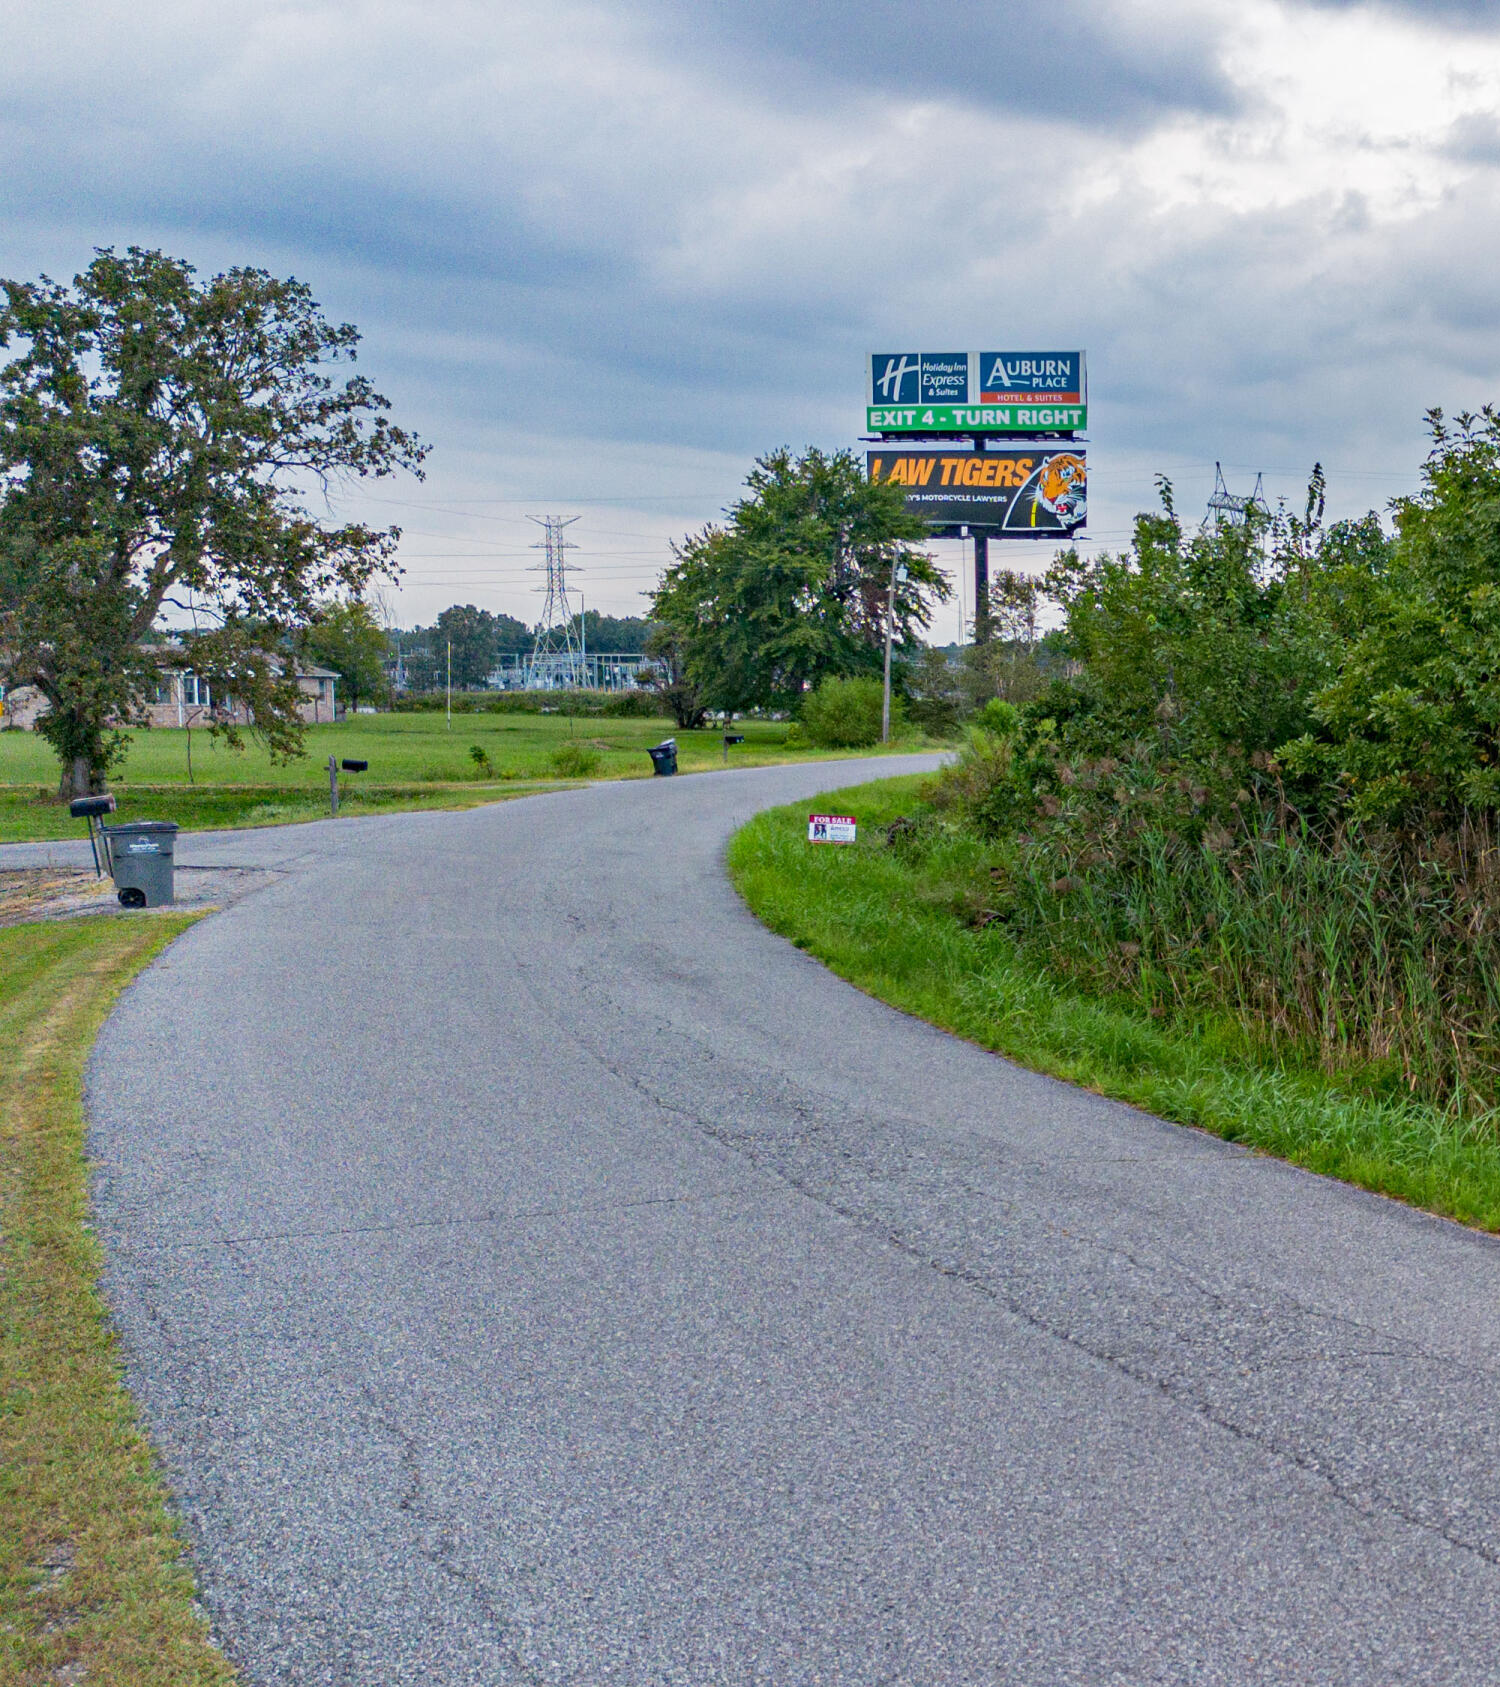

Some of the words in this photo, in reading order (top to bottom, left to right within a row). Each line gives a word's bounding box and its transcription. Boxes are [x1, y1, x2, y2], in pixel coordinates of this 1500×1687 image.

[923, 362, 953, 373] Holiday
[954, 362, 967, 372] Inn
[986, 358, 1071, 387] AUBURN
[923, 374, 965, 388] Express
[1032, 377, 1068, 388] PLACE
[928, 388, 935, 396] &
[936, 388, 959, 396] Suites
[997, 394, 1025, 402] HOTEL
[1026, 394, 1033, 402] &
[1034, 394, 1063, 402] SUITES
[870, 411, 916, 426] EXIT
[922, 410, 934, 425] 4
[952, 409, 1011, 425] TURN
[1017, 410, 1082, 425] RIGHT
[940, 458, 1033, 487] TIGERS
[921, 494, 971, 502] MOTORCYCLE
[972, 495, 1008, 503] LAWYERS
[814, 816, 830, 824] FOR
